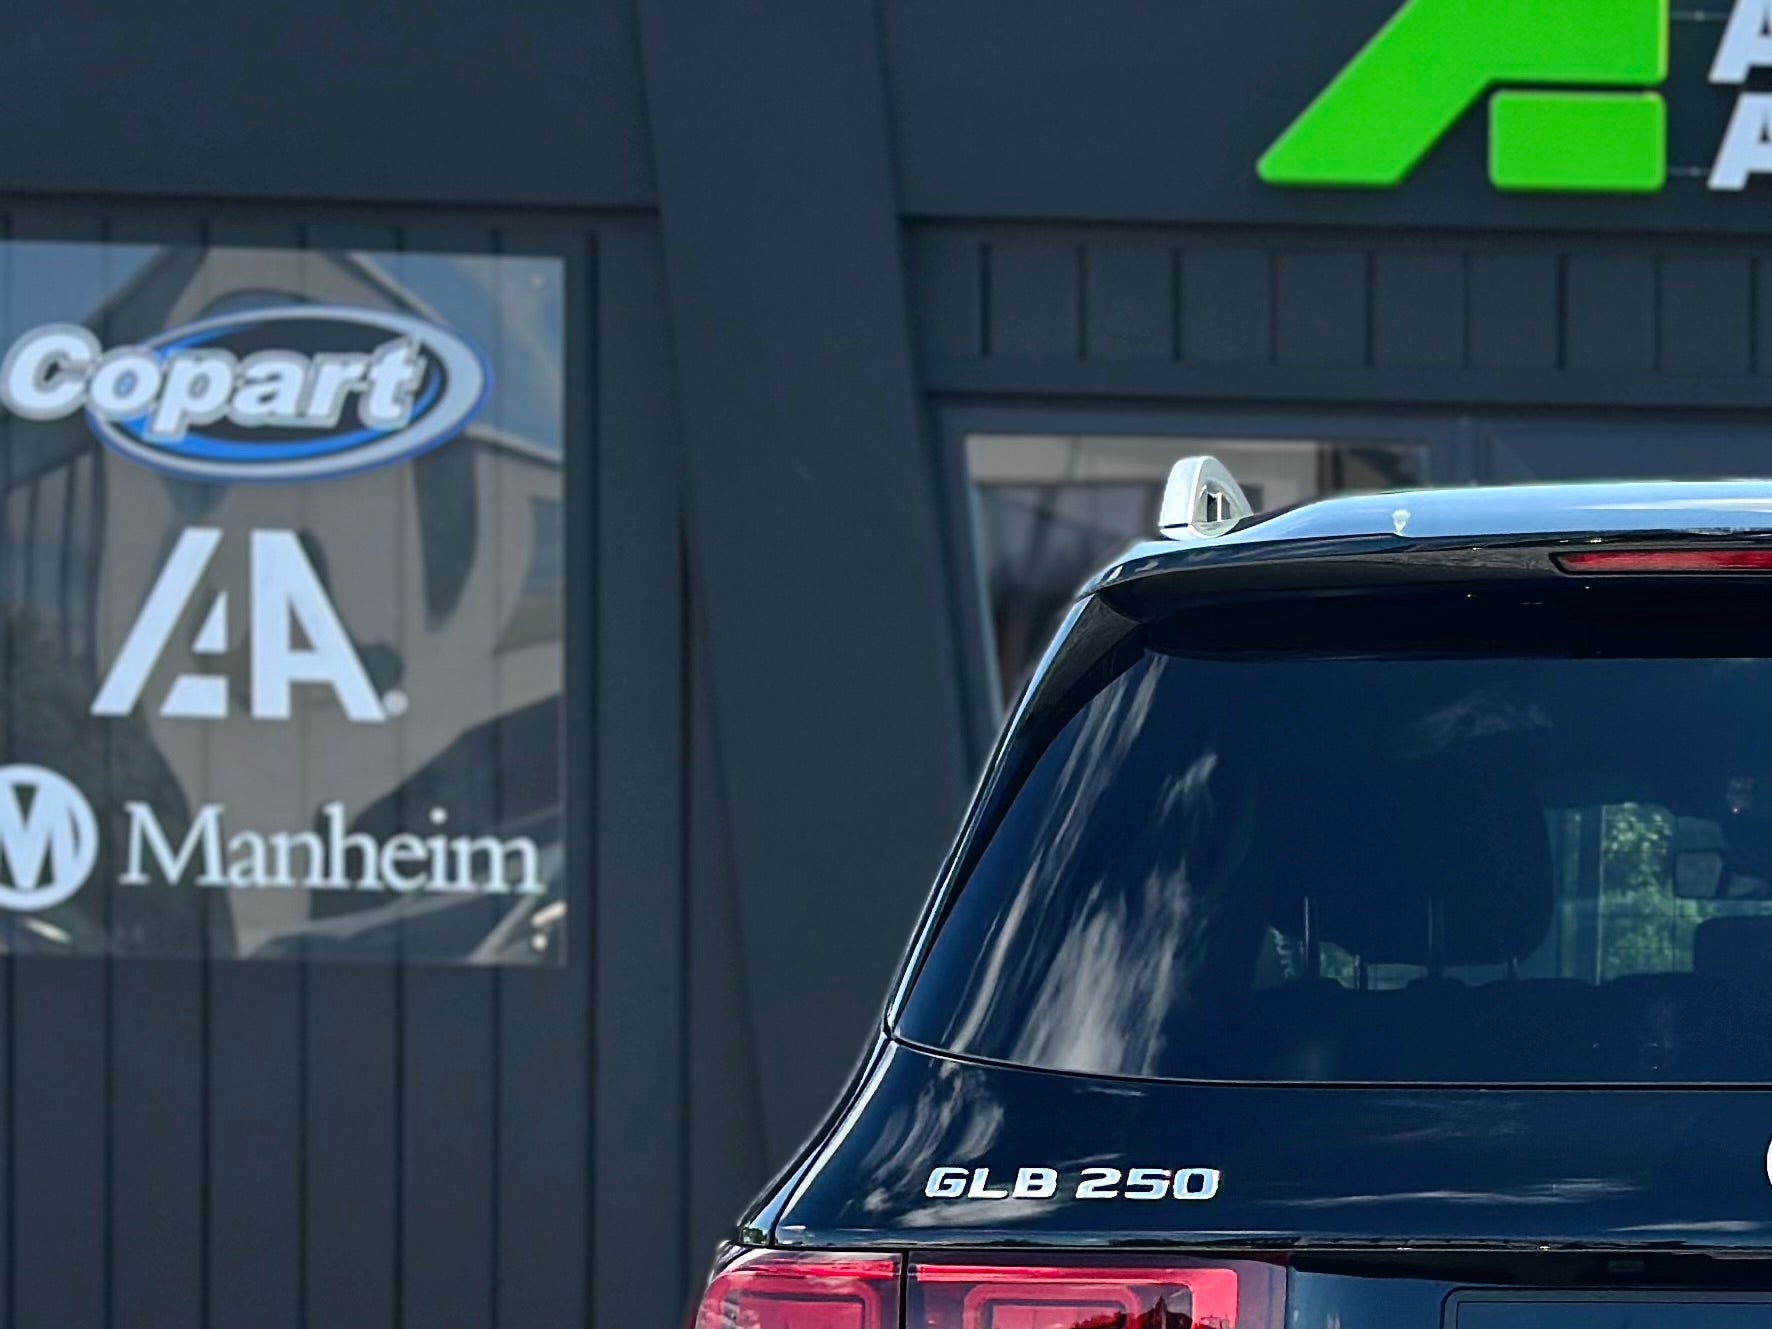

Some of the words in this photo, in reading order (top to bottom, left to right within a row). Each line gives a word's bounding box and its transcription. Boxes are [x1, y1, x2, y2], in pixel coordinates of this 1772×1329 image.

[4, 324, 424, 440] Copart
[118, 800, 546, 894] Manheim
[924, 1167, 1058, 1198] GLB
[1076, 1168, 1220, 1199] 250
